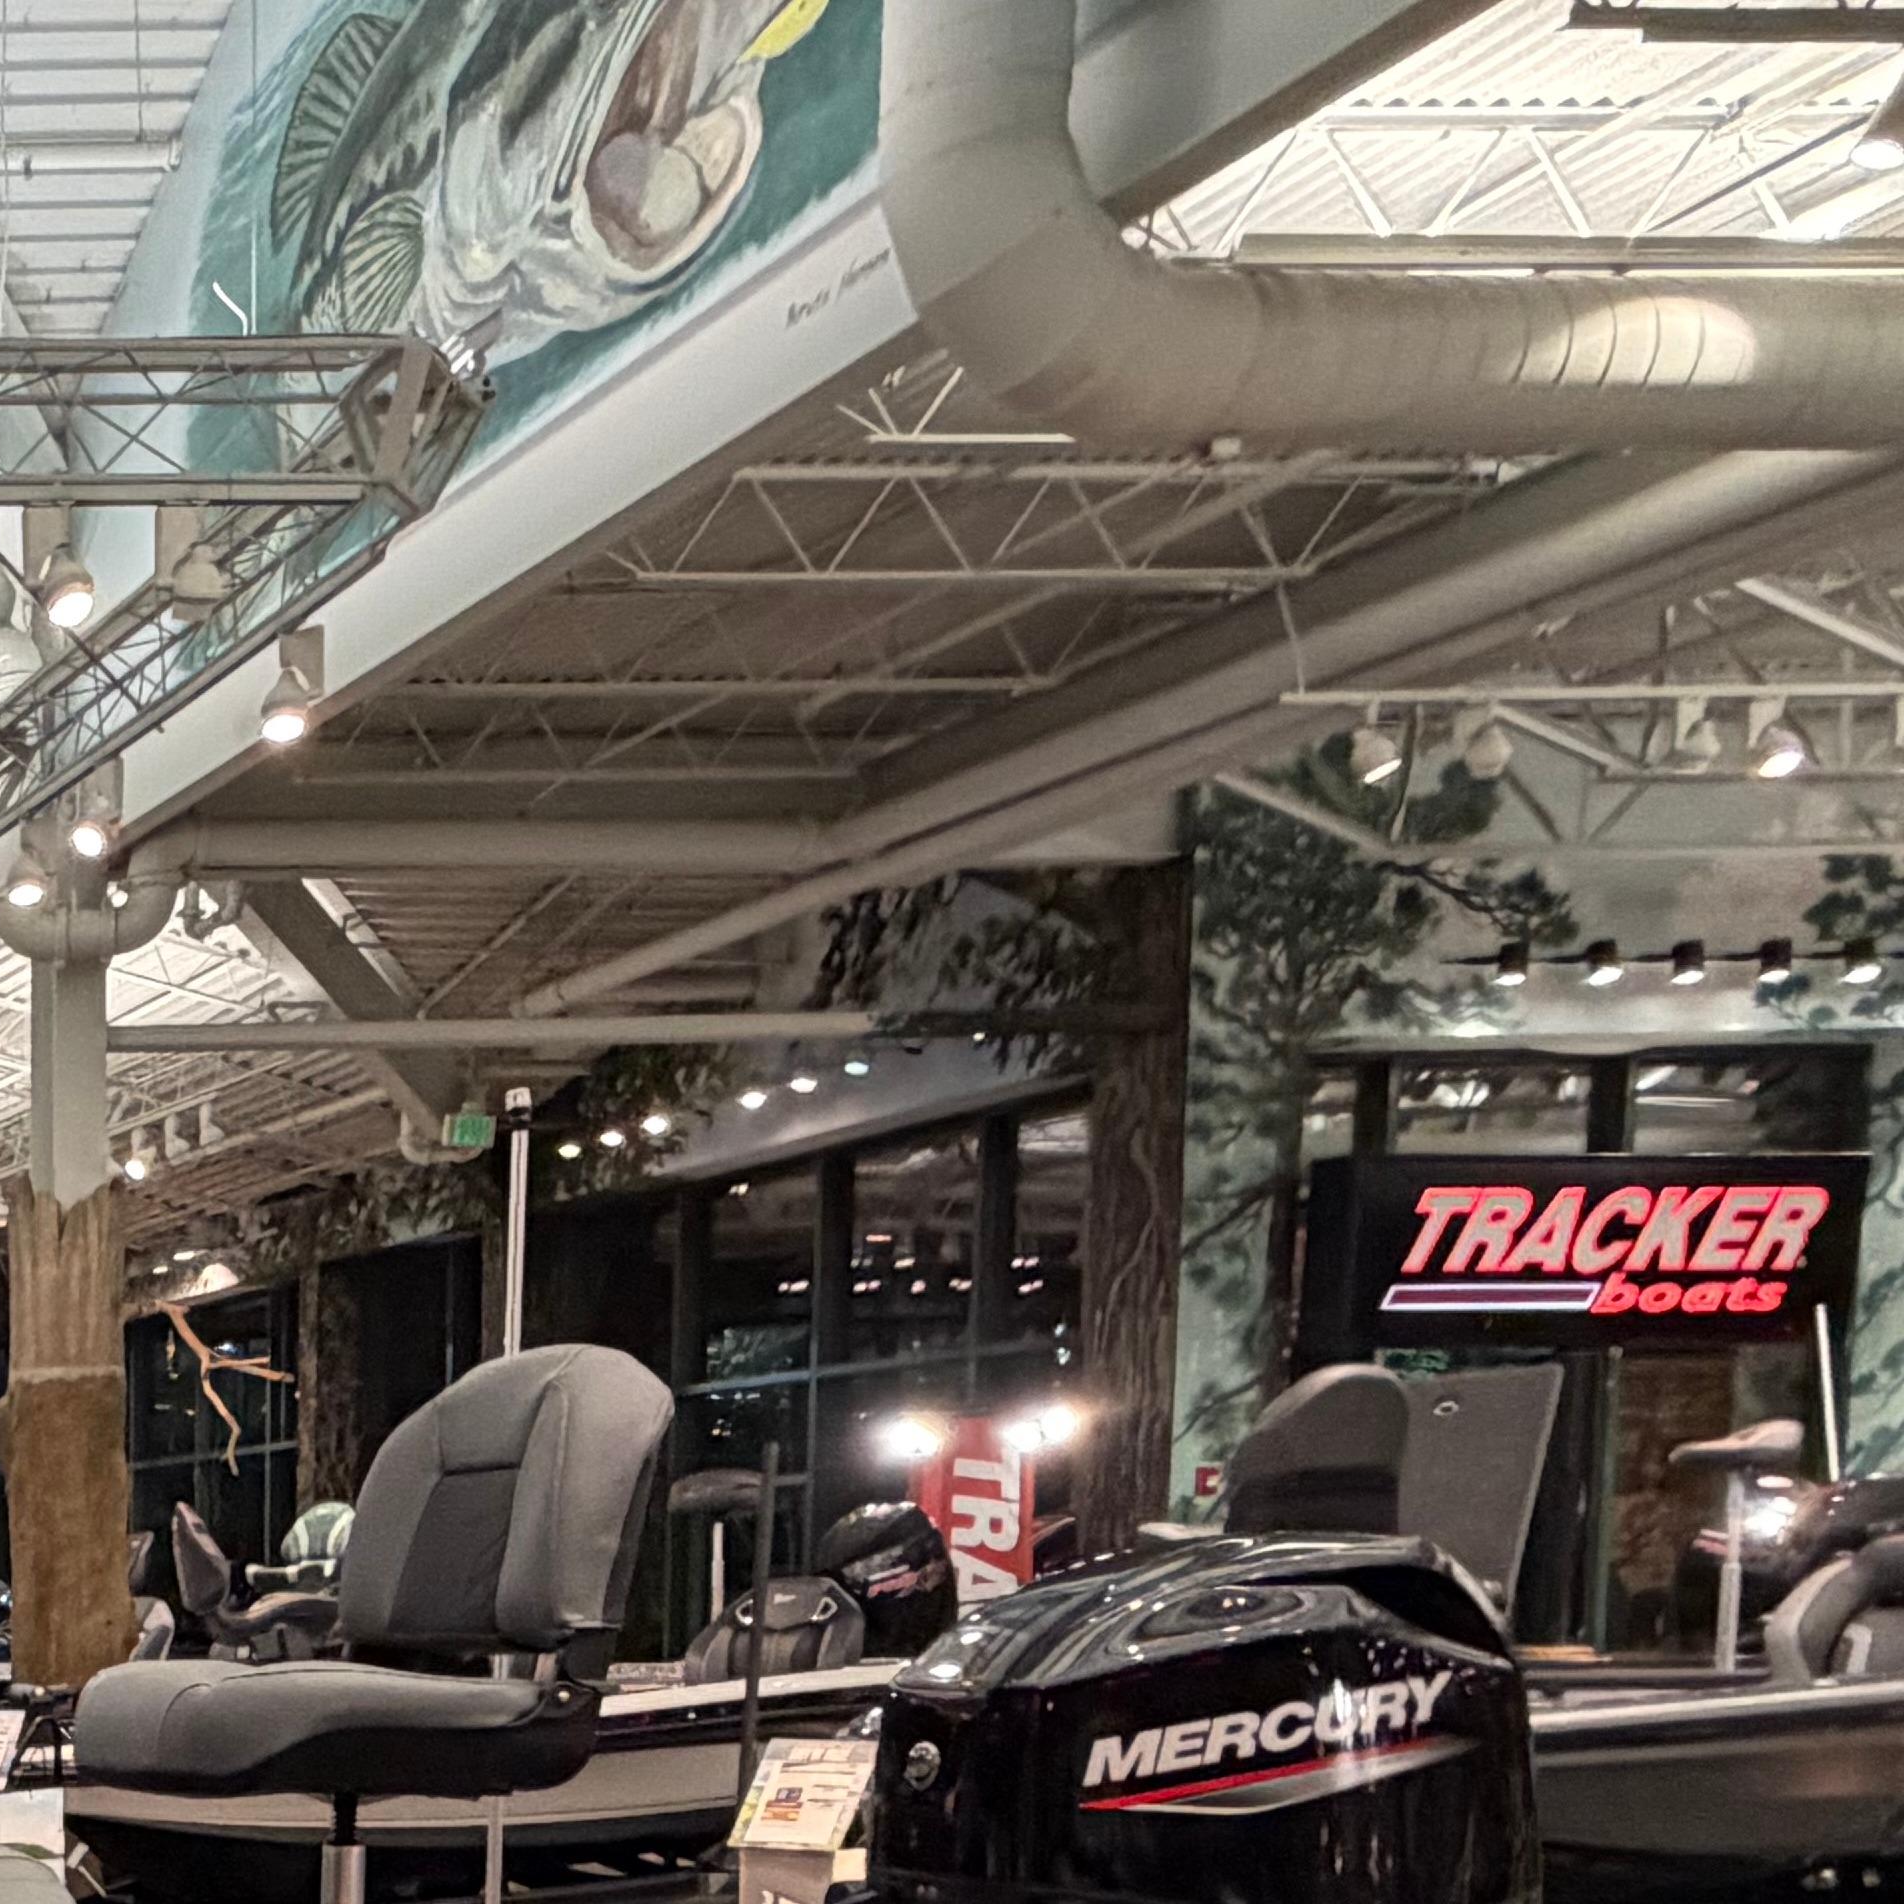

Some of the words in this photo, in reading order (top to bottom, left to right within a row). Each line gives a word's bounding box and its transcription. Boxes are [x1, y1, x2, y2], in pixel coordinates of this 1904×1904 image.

[1401, 1186, 1810, 1273] TRACKER
[1590, 1272, 1788, 1314] boats
[950, 1446, 1021, 1620] TRA
[1082, 1670, 1452, 1788] MERCURY
